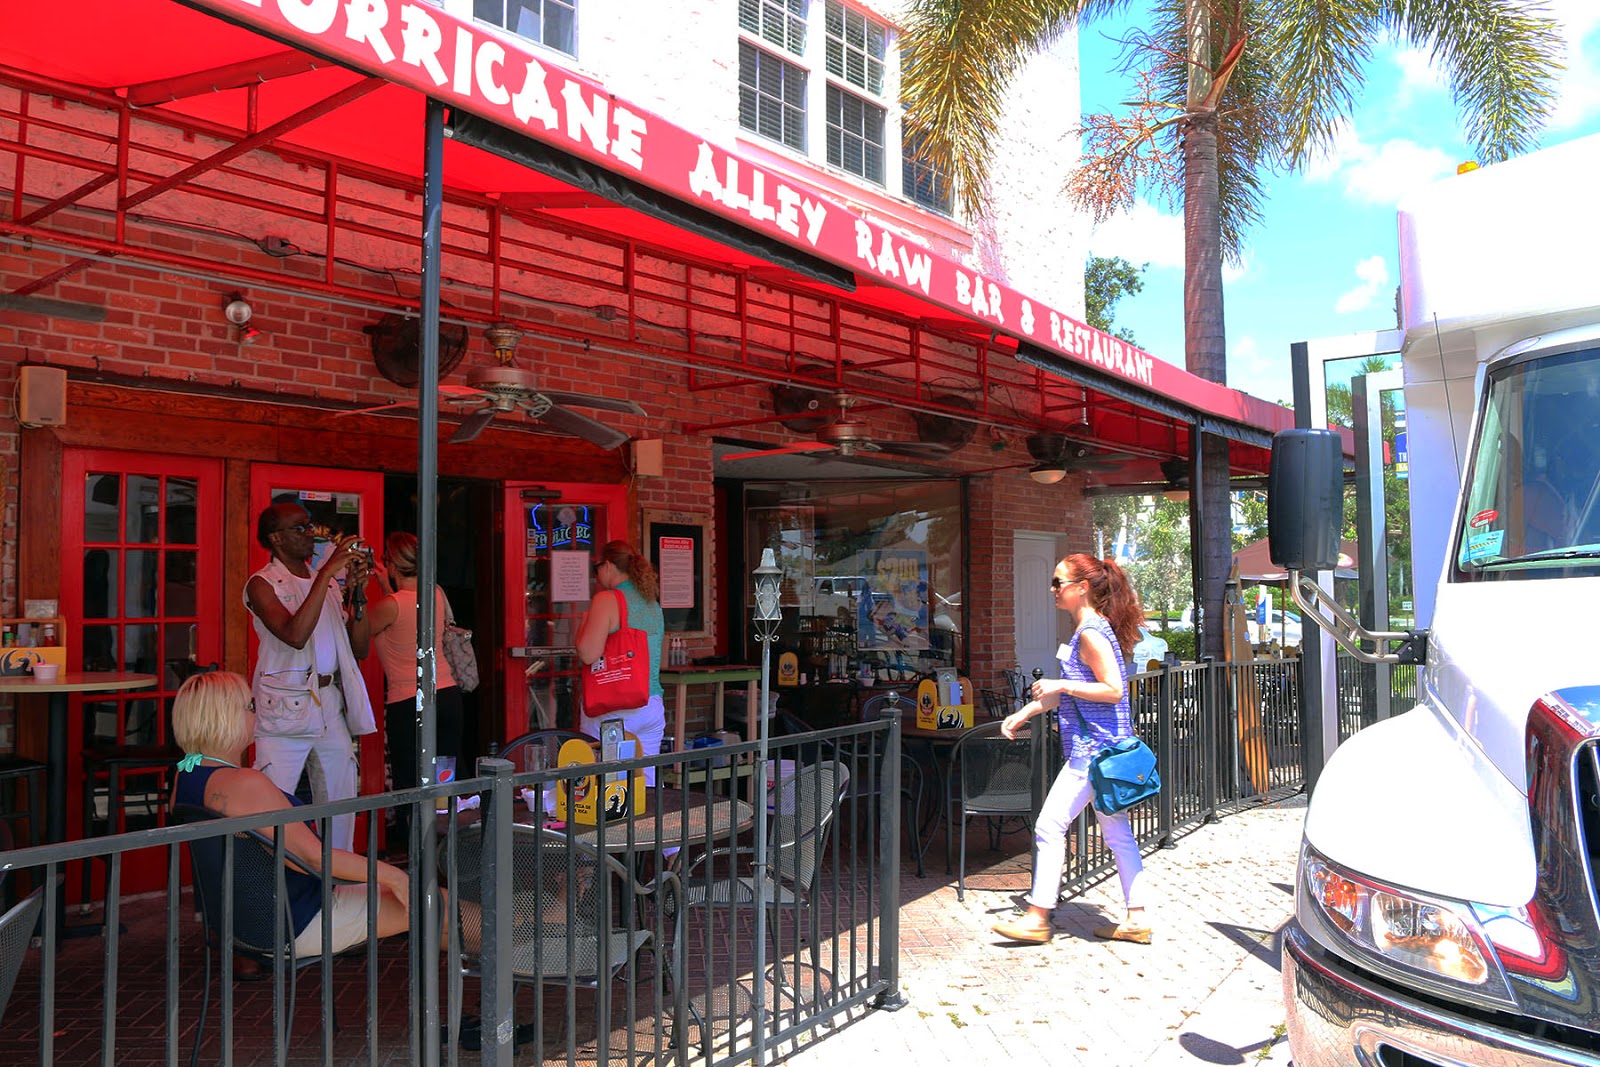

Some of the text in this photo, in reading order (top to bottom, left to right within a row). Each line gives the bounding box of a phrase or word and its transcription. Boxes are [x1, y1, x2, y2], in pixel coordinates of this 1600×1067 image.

[241, 0, 1154, 386] RRICANE ALLEY RAW BAR & RESTAURANT
